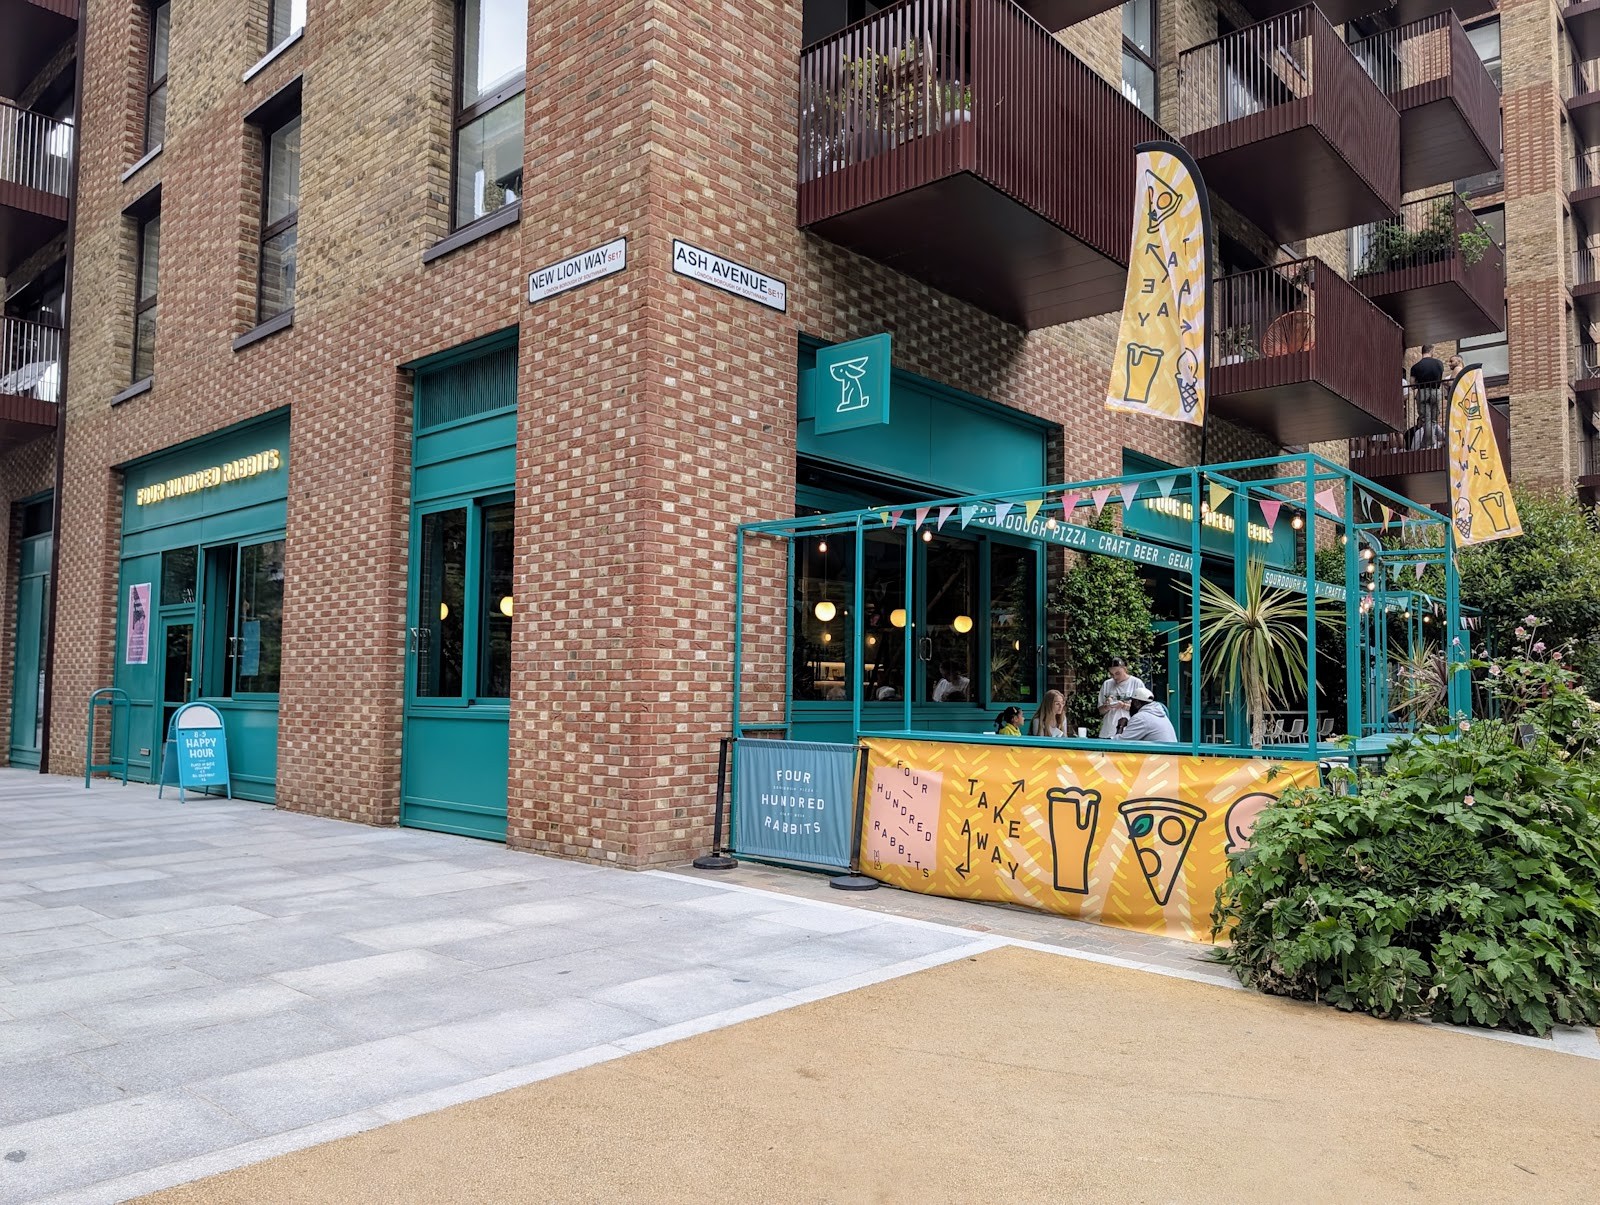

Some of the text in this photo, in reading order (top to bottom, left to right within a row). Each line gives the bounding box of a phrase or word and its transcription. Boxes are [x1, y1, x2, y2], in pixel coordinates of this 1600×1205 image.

[531, 249, 622, 291] NEW LION WAY SE17
[543, 285, 559, 295] LONDON
[559, 279, 577, 289] BOROUGH
[583, 267, 608, 281] SOUTHWARK
[676, 247, 784, 300] ASH AVENUE SE17
[694, 270, 713, 281] LONDON
[713, 277, 736, 290] BOROUGH
[742, 288, 768, 302] SOUTHWARK
[1455, 426, 1489, 460] TAKE
[136, 449, 280, 506] FOUR HUNDRED RABBITS
[1051, 523, 1087, 547] PIZZA
[1098, 535, 1131, 556] CRAFT
[1133, 543, 1159, 563] BEER
[1324, 585, 1342, 599] CRAFT
[185, 737, 217, 748] HAPPY
[189, 748, 215, 758] HOUR
[776, 769, 811, 784] FOUR
[897, 760, 928, 794] FOUR
[761, 793, 825, 810] HUNDRED
[877, 783, 932, 842] HUNDRED
[968, 778, 1021, 838] TAKE
[764, 816, 821, 835] RABBITS
[874, 820, 930, 878] RABBITS
[961, 819, 1019, 880] AWAY
